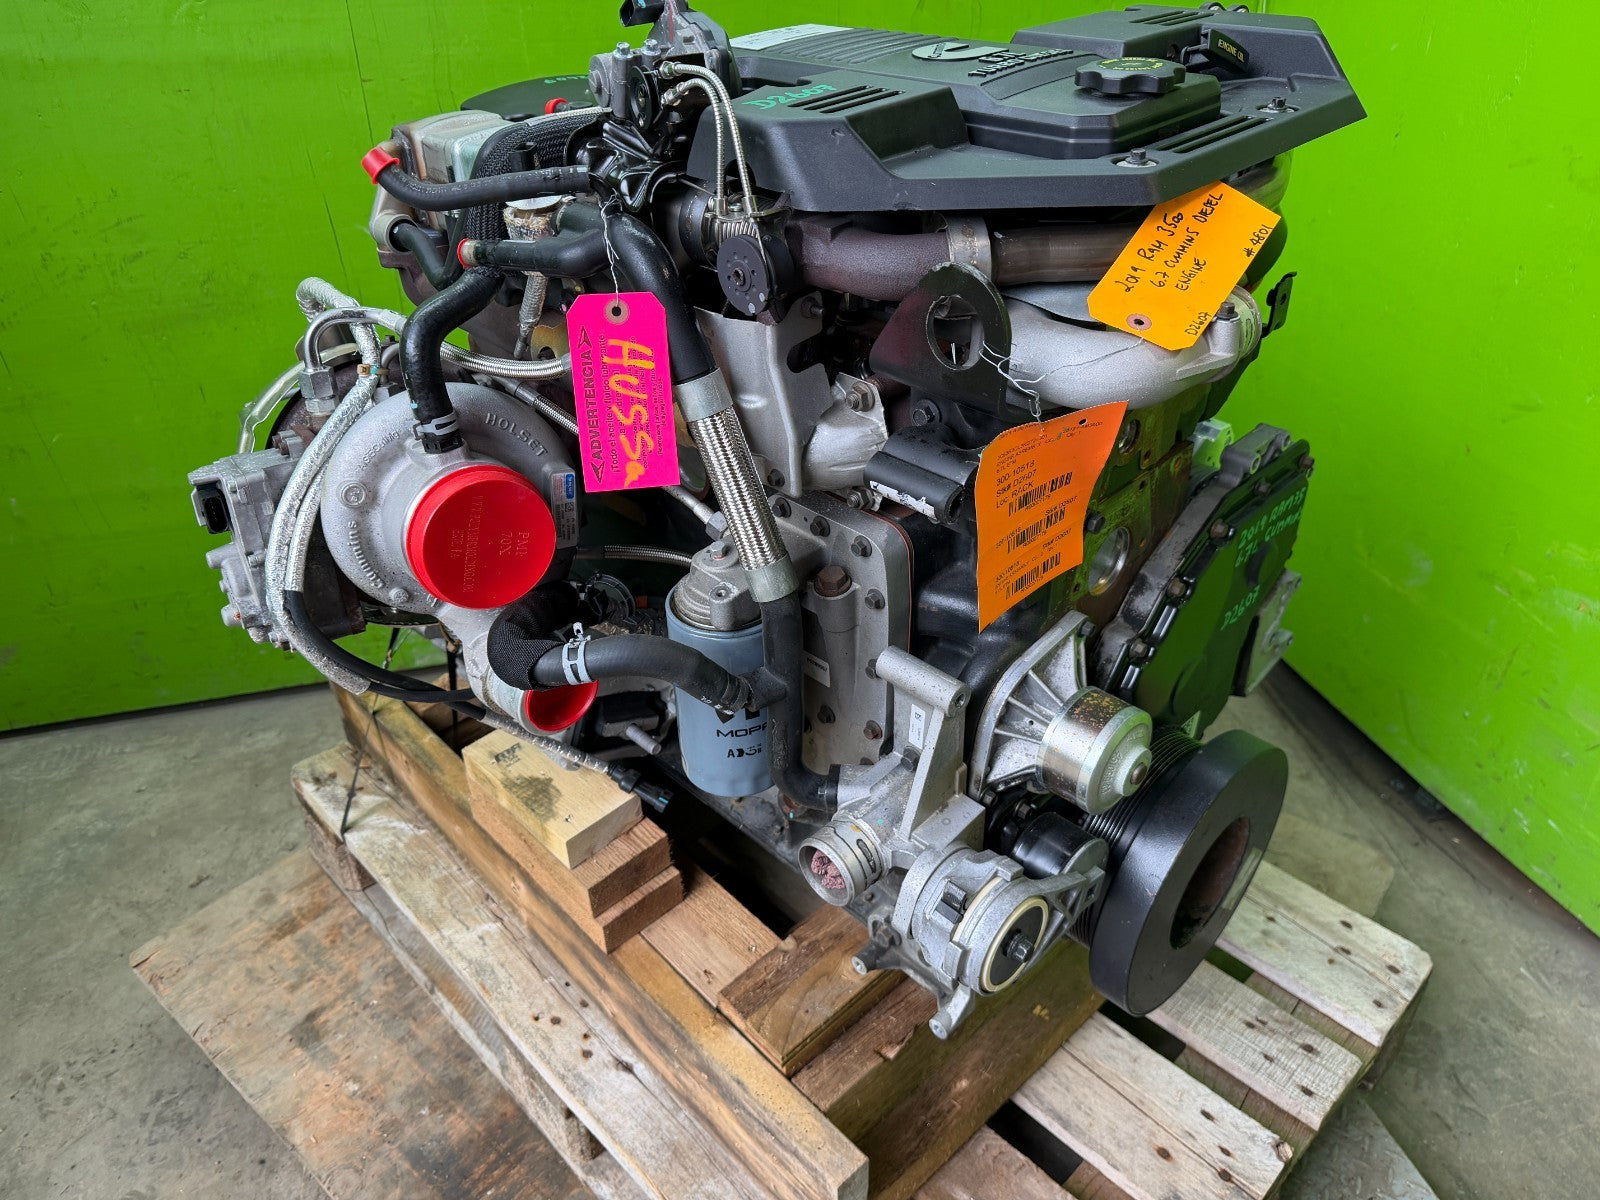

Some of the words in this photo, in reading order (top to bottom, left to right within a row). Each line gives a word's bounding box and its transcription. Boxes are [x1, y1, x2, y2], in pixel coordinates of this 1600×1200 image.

[1218, 39, 1237, 57] ENGINE
[1115, 267, 1145, 292] 2019
[1138, 240, 1169, 261] RAM
[1157, 212, 1184, 237] 3500
[1150, 271, 1170, 288] 6.7
[1165, 227, 1199, 268] CUMMINS
[1192, 193, 1223, 223] DIESEL
[1175, 257, 1207, 291] ENGINE
[581, 350, 603, 460] ADVERTENCIA
[603, 379, 611, 404] fluido
[486, 413, 549, 457] HOLSET
